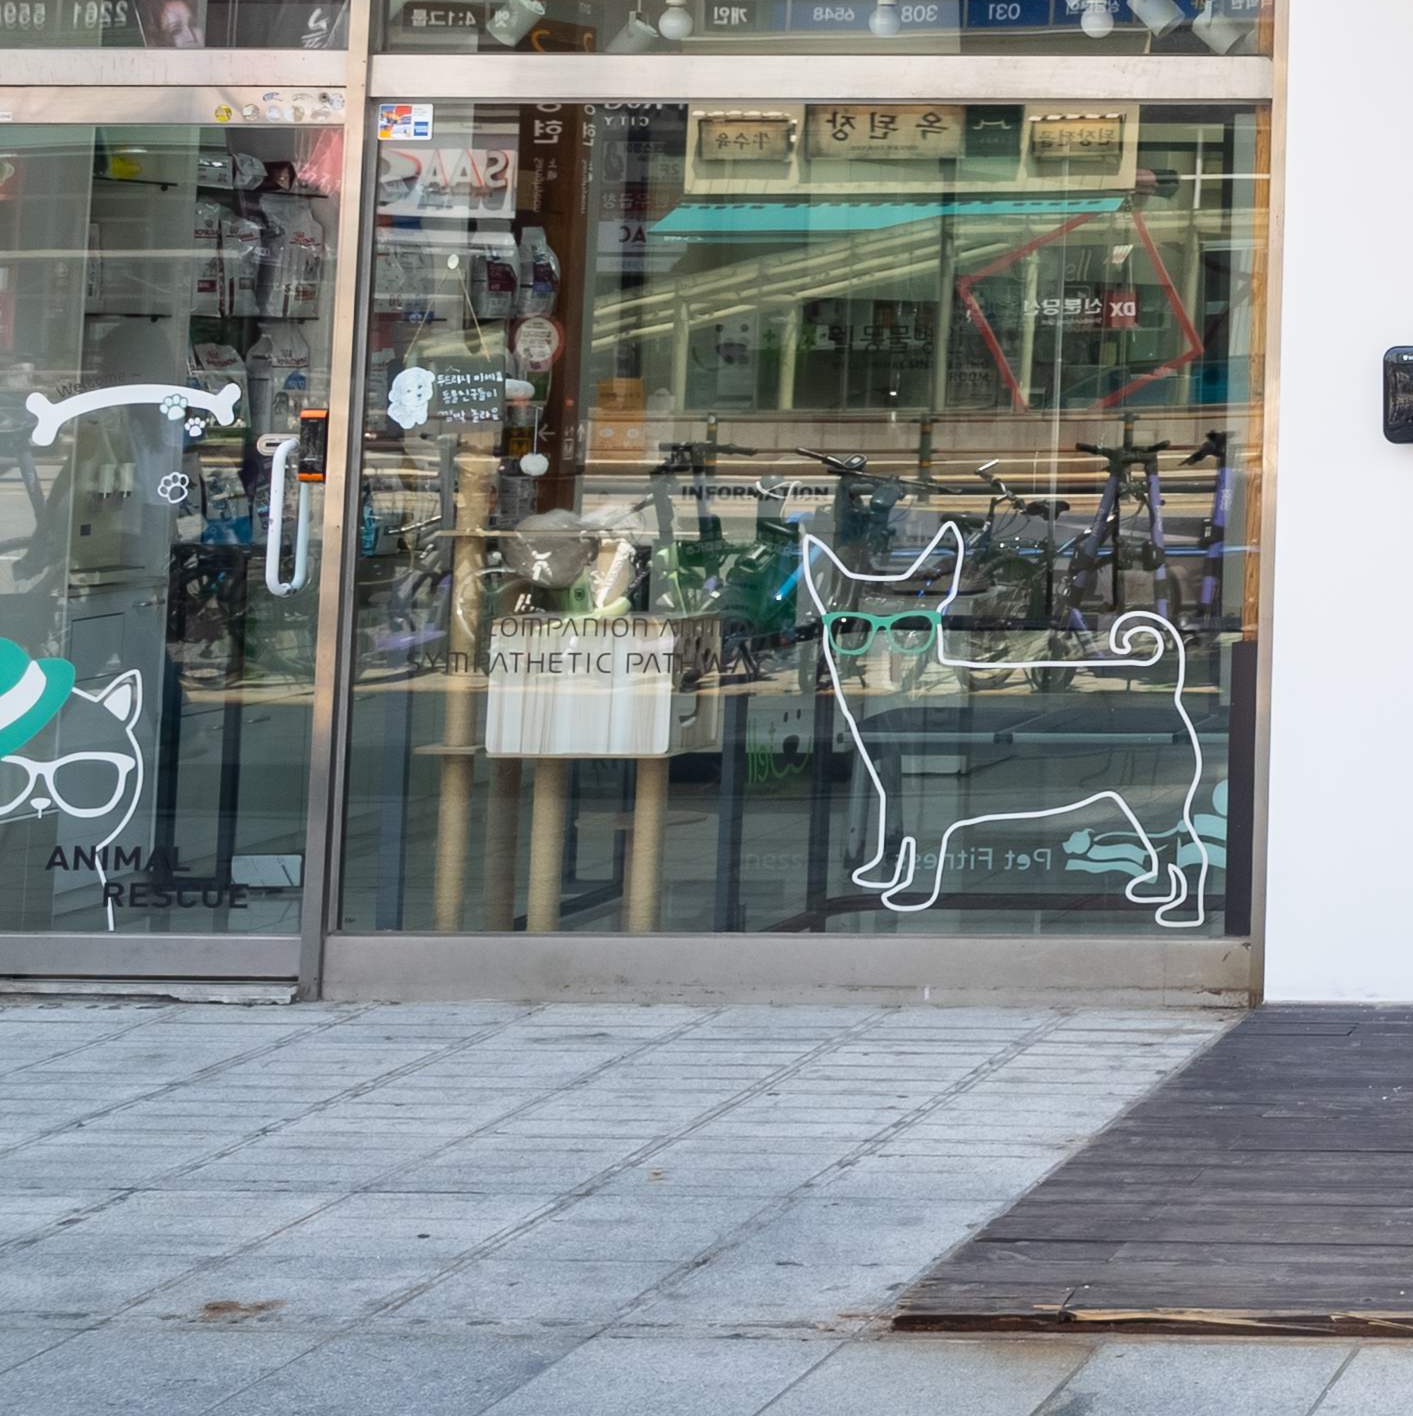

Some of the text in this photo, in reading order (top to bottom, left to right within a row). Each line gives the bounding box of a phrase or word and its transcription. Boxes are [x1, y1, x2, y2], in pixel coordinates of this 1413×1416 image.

[681, 485, 828, 501] INFORMATION
[486, 617, 649, 638] COMPANION
[406, 651, 612, 674] SYMPATHETIC
[45, 845, 191, 871] ANIMAL
[101, 883, 250, 910] RESCUE
